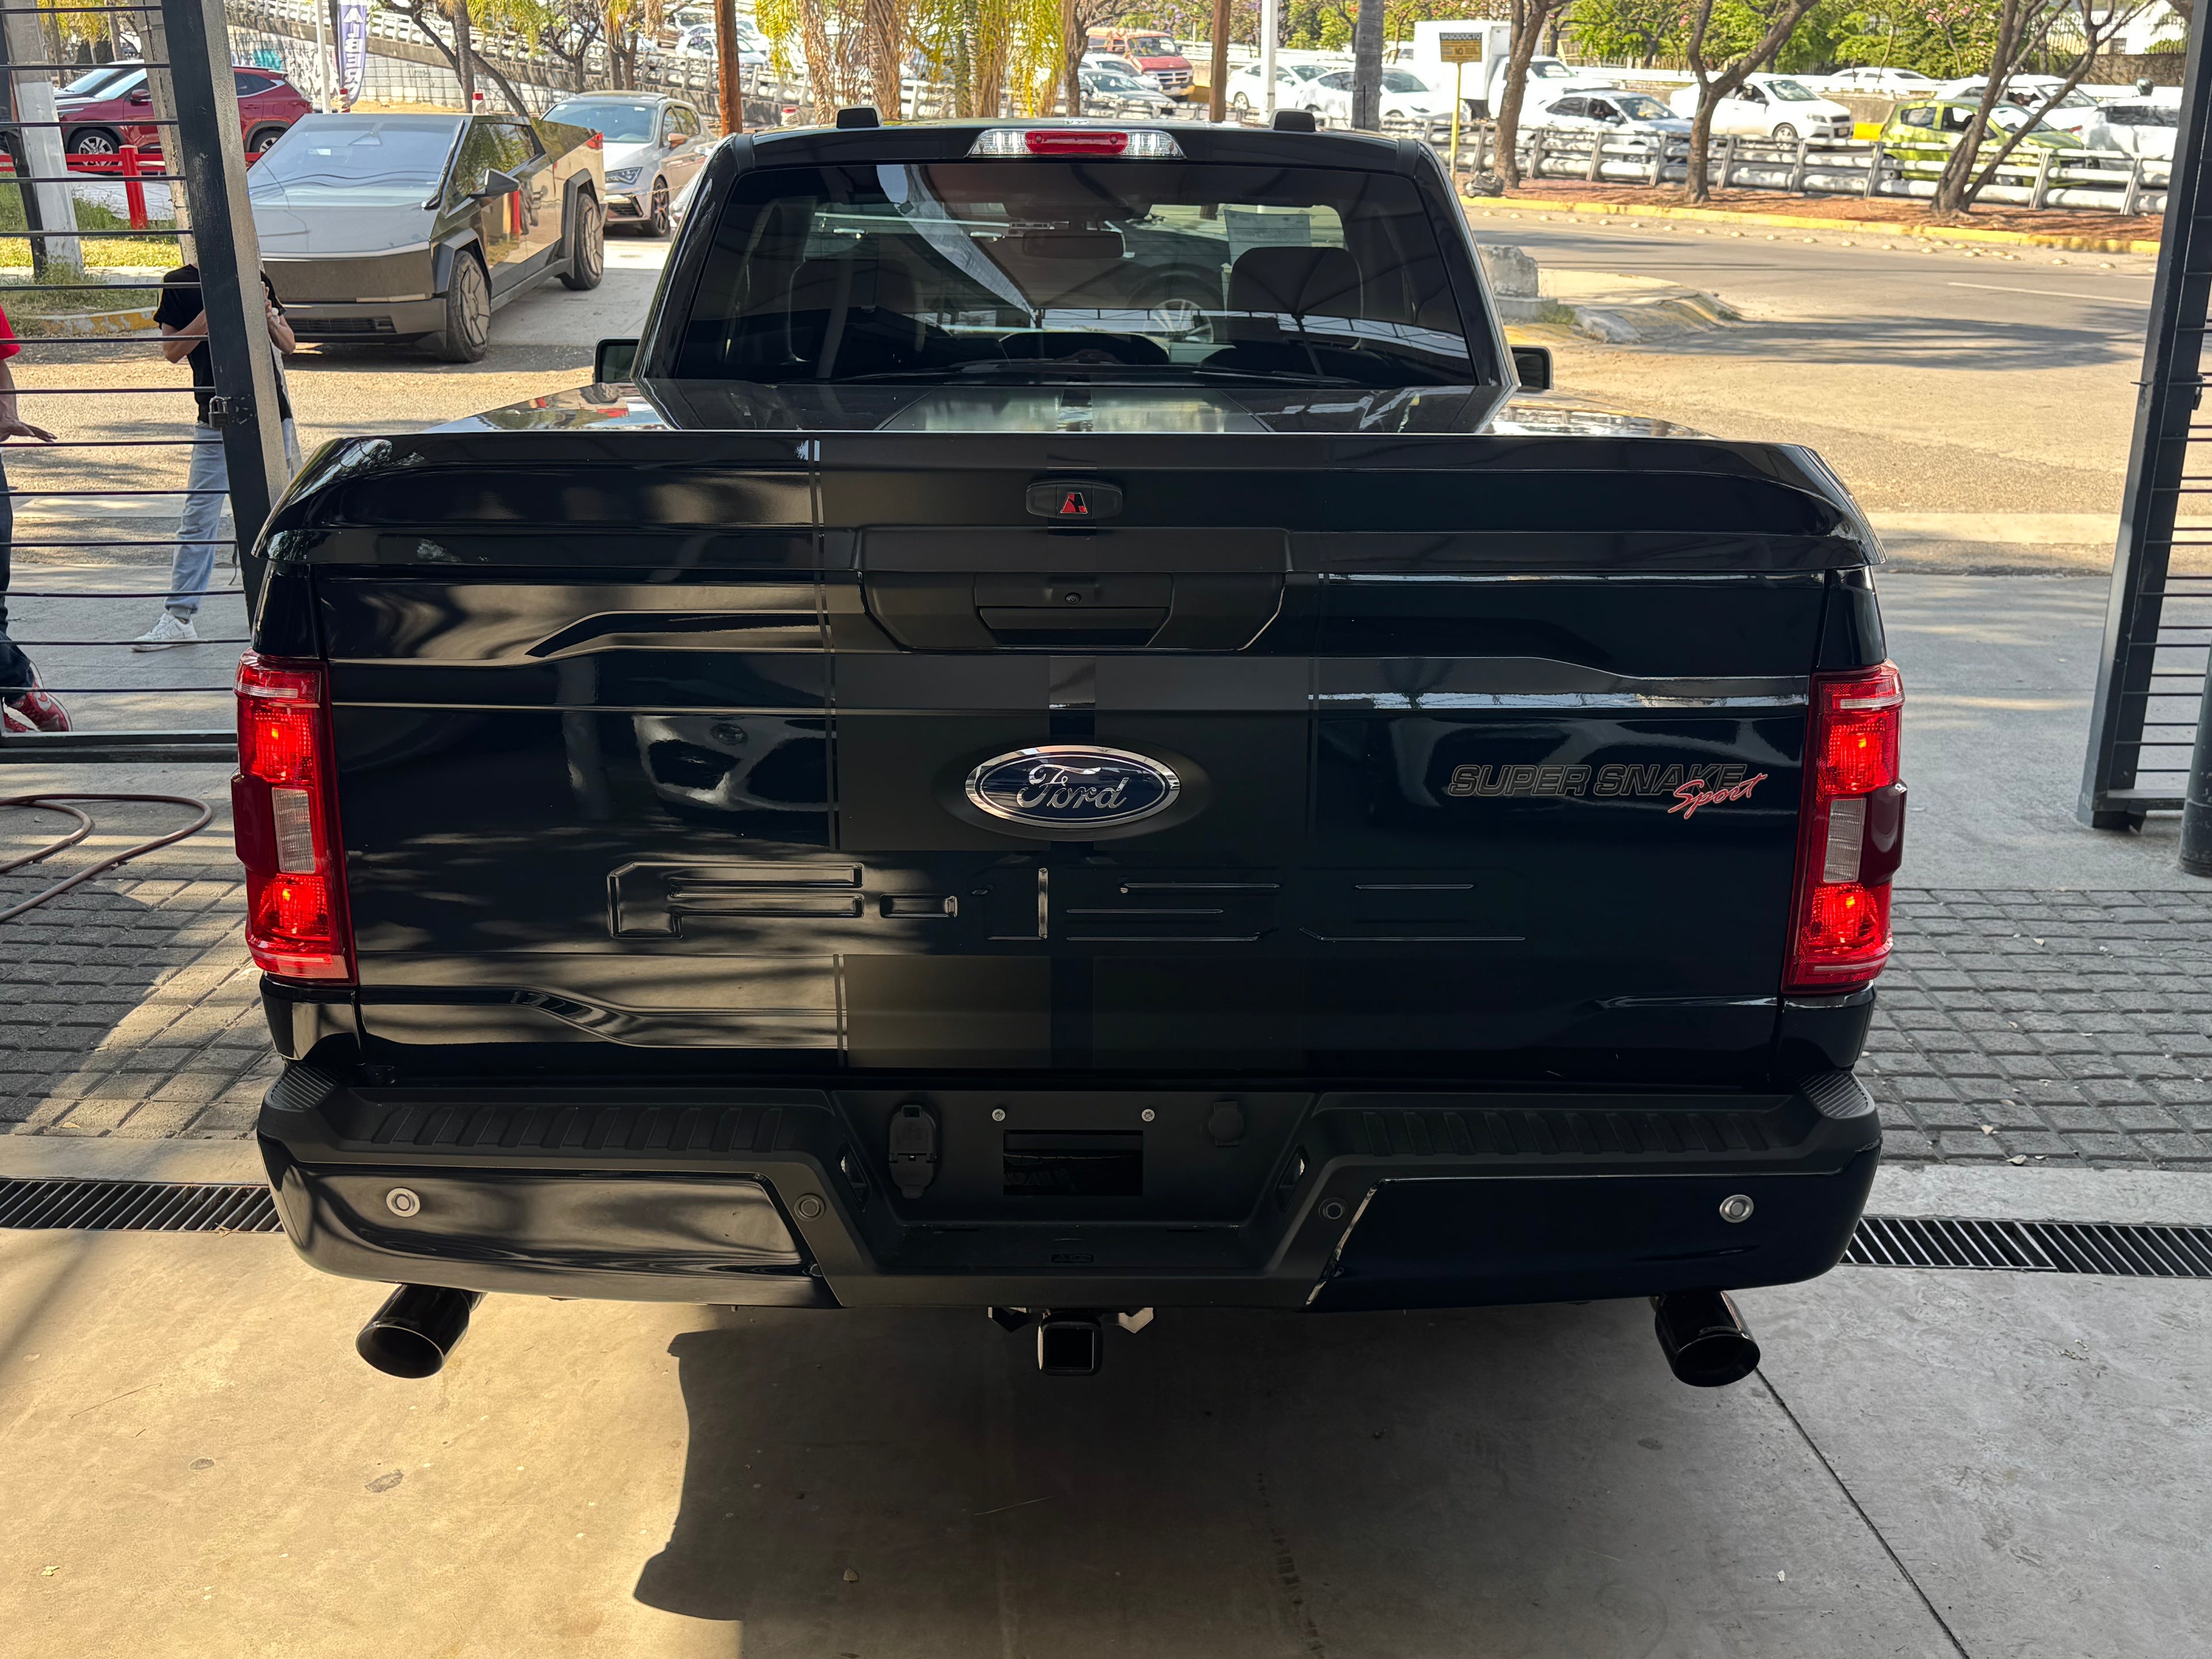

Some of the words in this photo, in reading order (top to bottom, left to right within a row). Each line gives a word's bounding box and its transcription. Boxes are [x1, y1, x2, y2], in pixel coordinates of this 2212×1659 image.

[1017, 764, 1130, 809] Ford
[1448, 764, 1592, 796] SUPER
[1593, 763, 1747, 796] SNAKE
[1668, 772, 1768, 820] Sport
